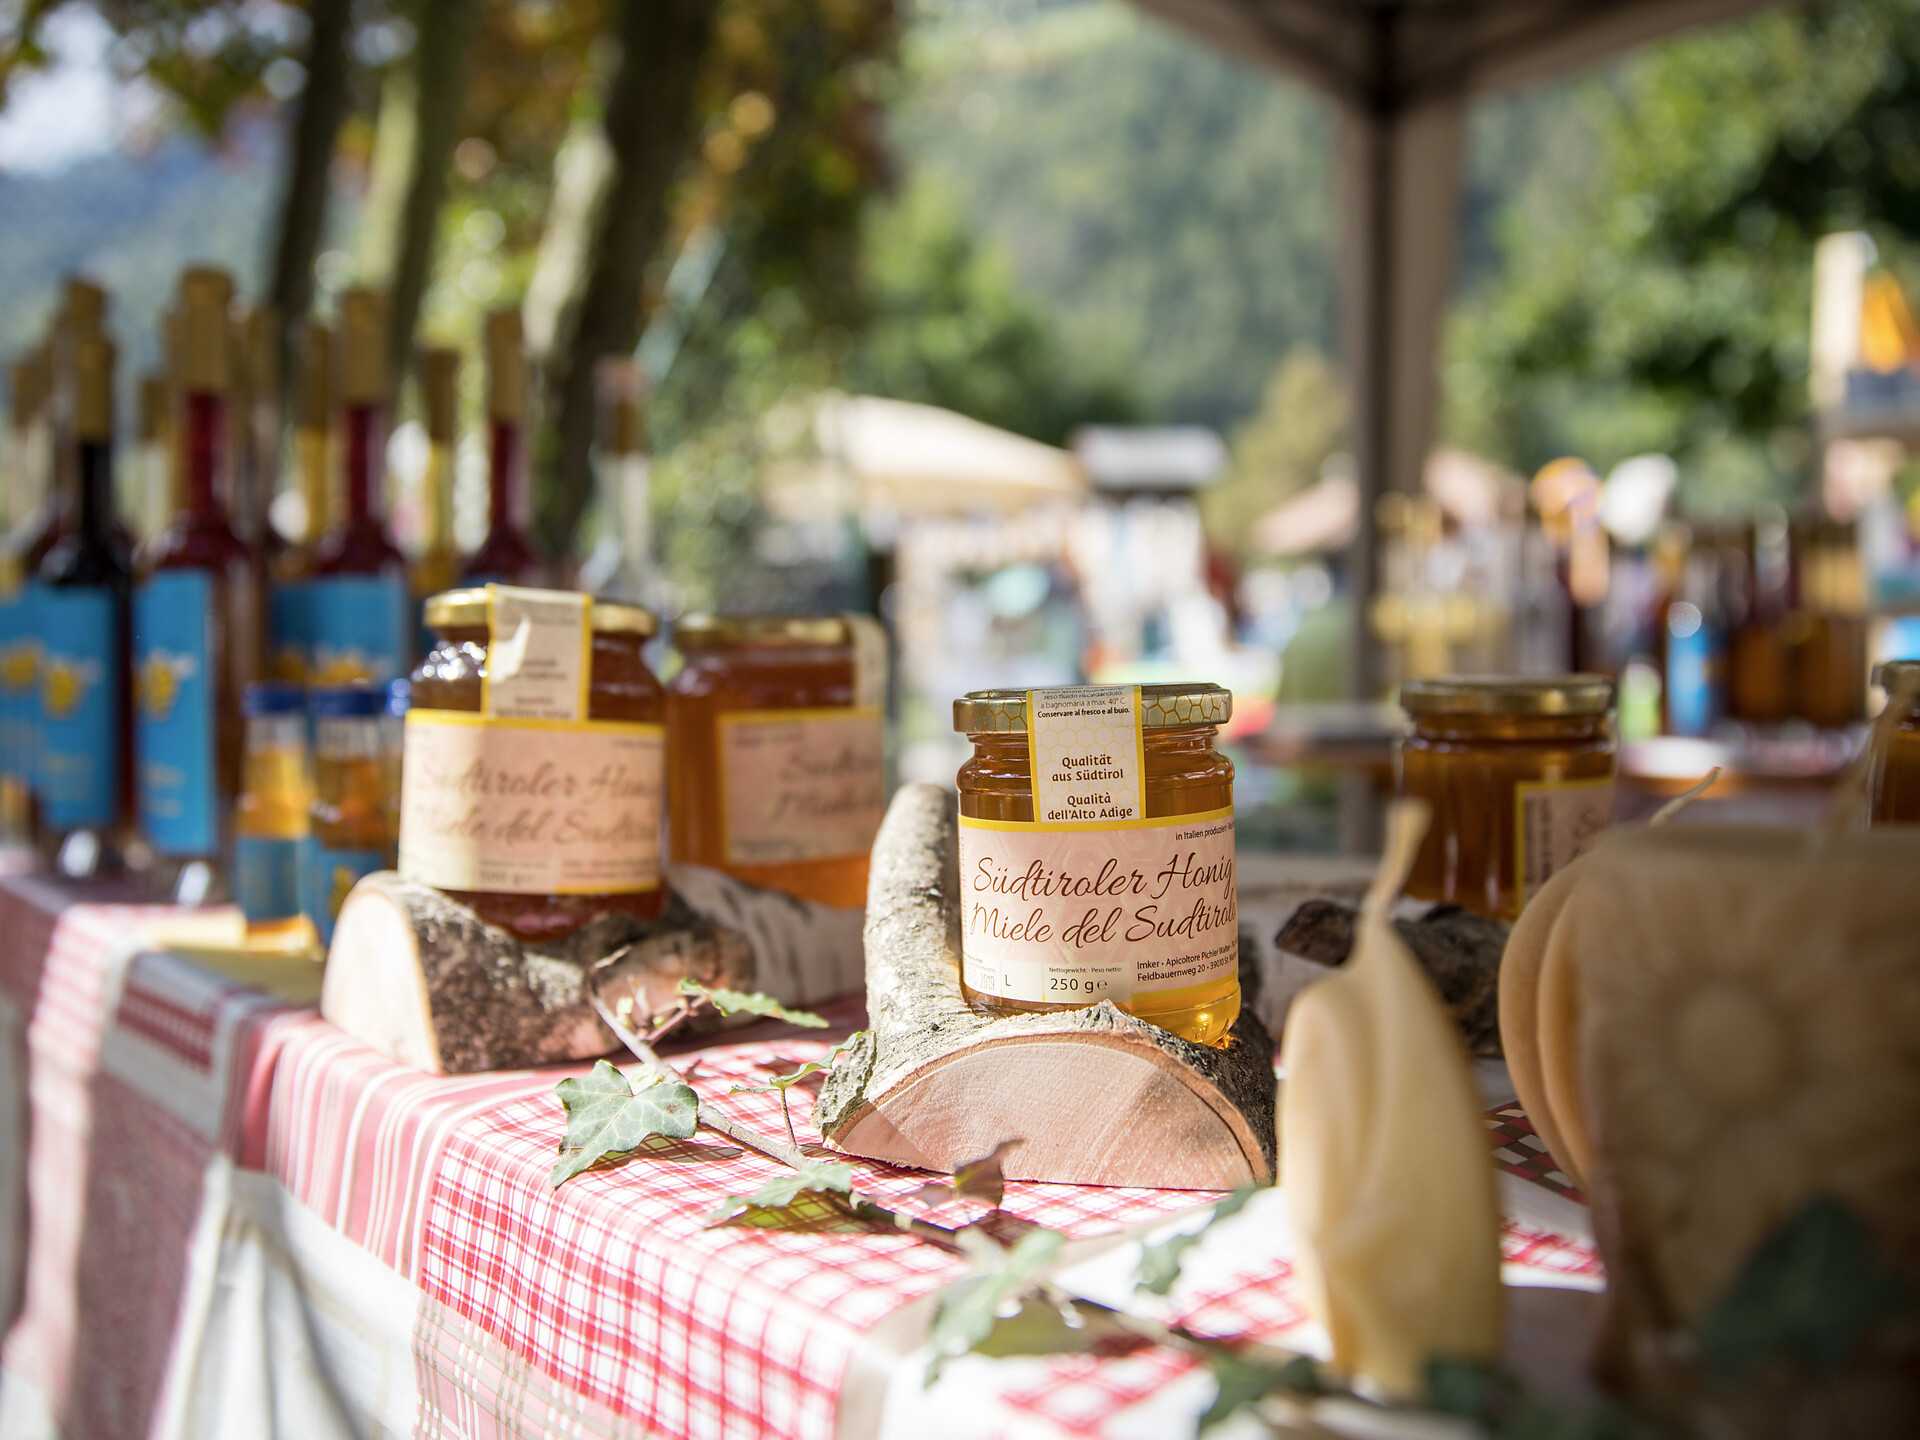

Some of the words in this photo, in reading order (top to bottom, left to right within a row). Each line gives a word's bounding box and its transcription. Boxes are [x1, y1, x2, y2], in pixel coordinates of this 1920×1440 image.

[1037, 710, 1073, 718] Conservare
[1081, 708, 1101, 716] fresco
[1107, 706, 1113, 714] al
[1113, 706, 1130, 714] buio.
[1045, 700, 1085, 711] bagnomaria
[1061, 754, 1112, 769] Qualität
[1051, 773, 1072, 782] aus
[1075, 768, 1124, 781] Südtirol
[1066, 791, 1111, 808] Qualità
[1099, 805, 1133, 820] Adige
[1175, 832, 1183, 841] in
[1183, 829, 1204, 840] Italien
[973, 856, 1148, 902] Südtiroler
[1150, 851, 1234, 900] Honig
[969, 902, 1054, 943] Miele
[1061, 906, 1123, 949] del
[1136, 960, 1160, 970] Imker
[1166, 953, 1201, 968] Apicoltore
[1201, 949, 1219, 961] Pichler
[1004, 974, 1012, 987] L
[1137, 966, 1197, 983] Feldbauernweg
[1197, 963, 1206, 974] 20
[1050, 977, 1079, 991] 250
